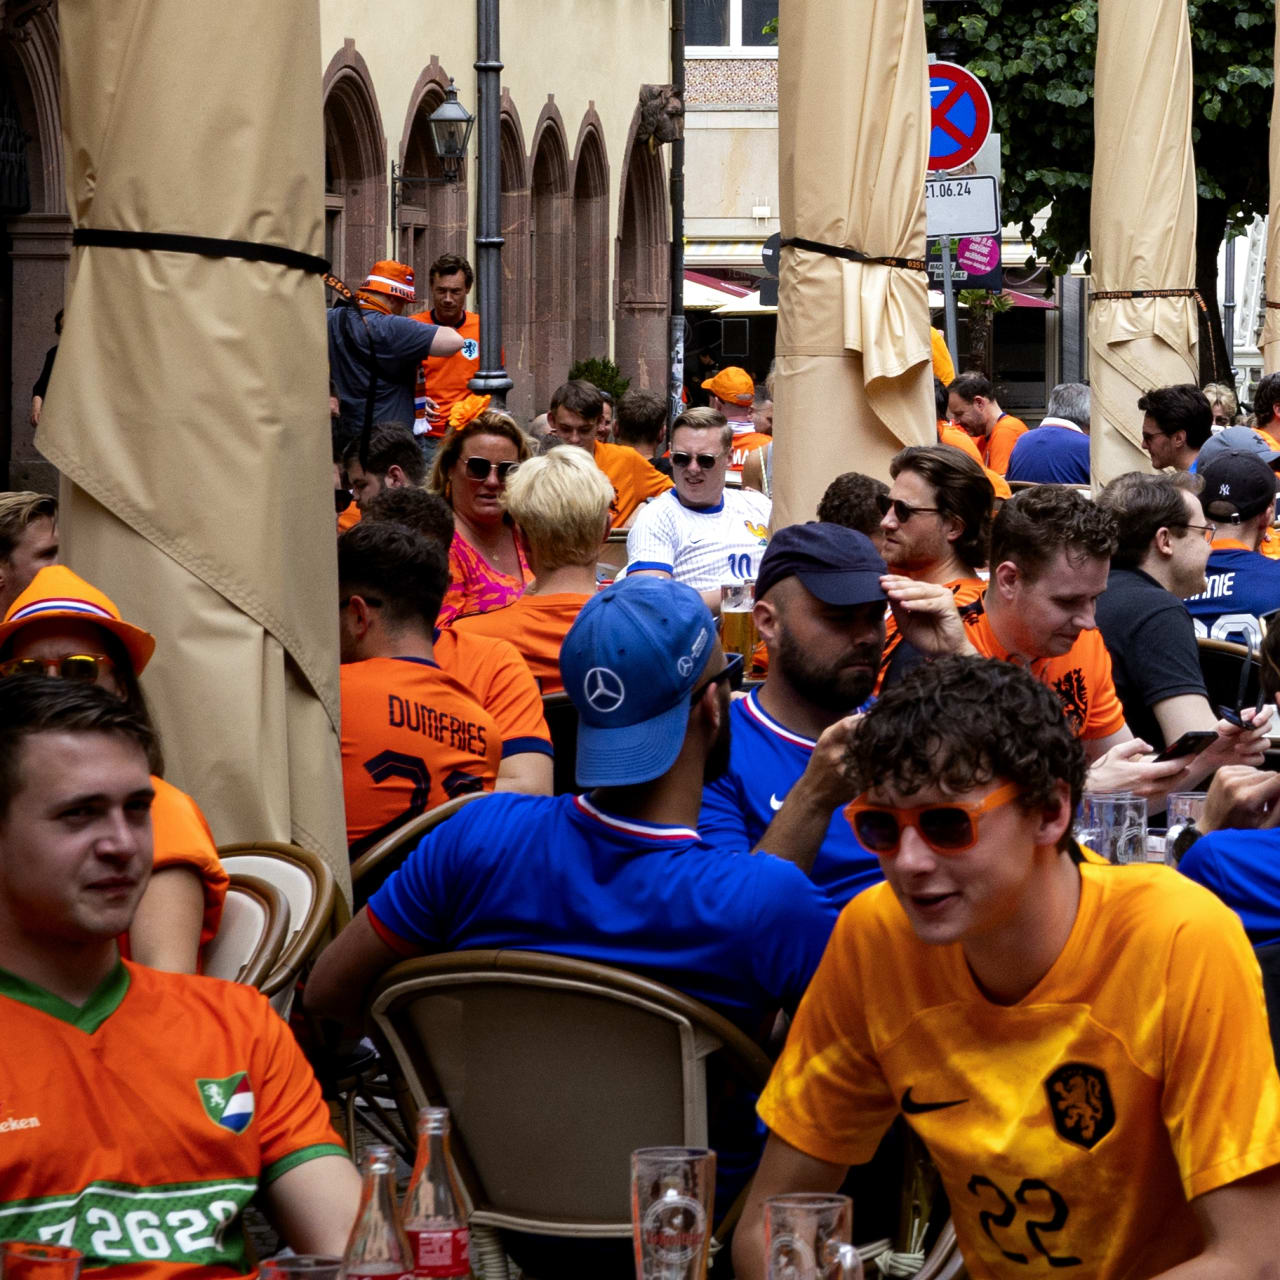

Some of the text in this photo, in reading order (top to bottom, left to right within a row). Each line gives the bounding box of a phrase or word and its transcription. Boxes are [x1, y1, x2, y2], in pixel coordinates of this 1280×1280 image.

[728, 553, 752, 579] 10
[388, 694, 488, 757] DUMFRIES
[967, 1174, 1083, 1268] 22
